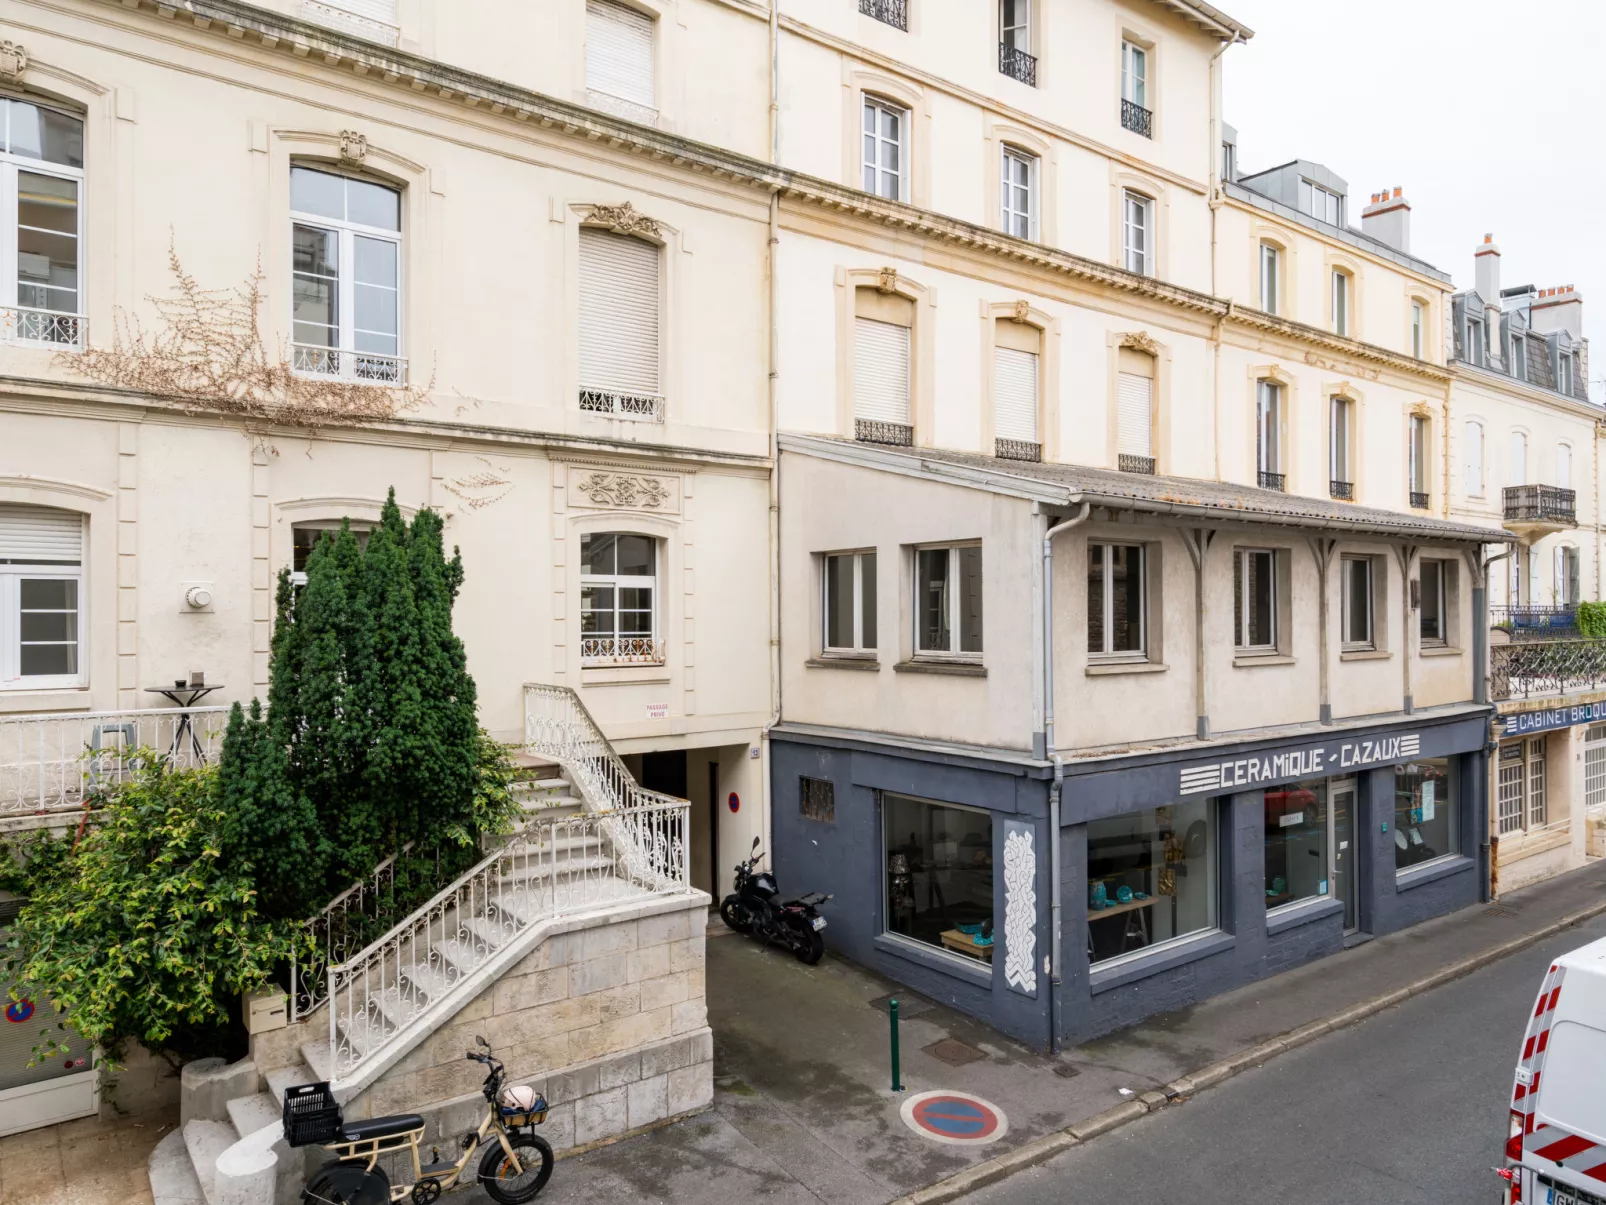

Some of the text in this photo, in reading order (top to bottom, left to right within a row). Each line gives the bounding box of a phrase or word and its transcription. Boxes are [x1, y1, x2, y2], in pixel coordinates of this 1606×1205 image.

[646, 703, 669, 711] PASSAGE
[1519, 708, 1568, 730] CABINET
[1340, 736, 1402, 768] CAZAUX
